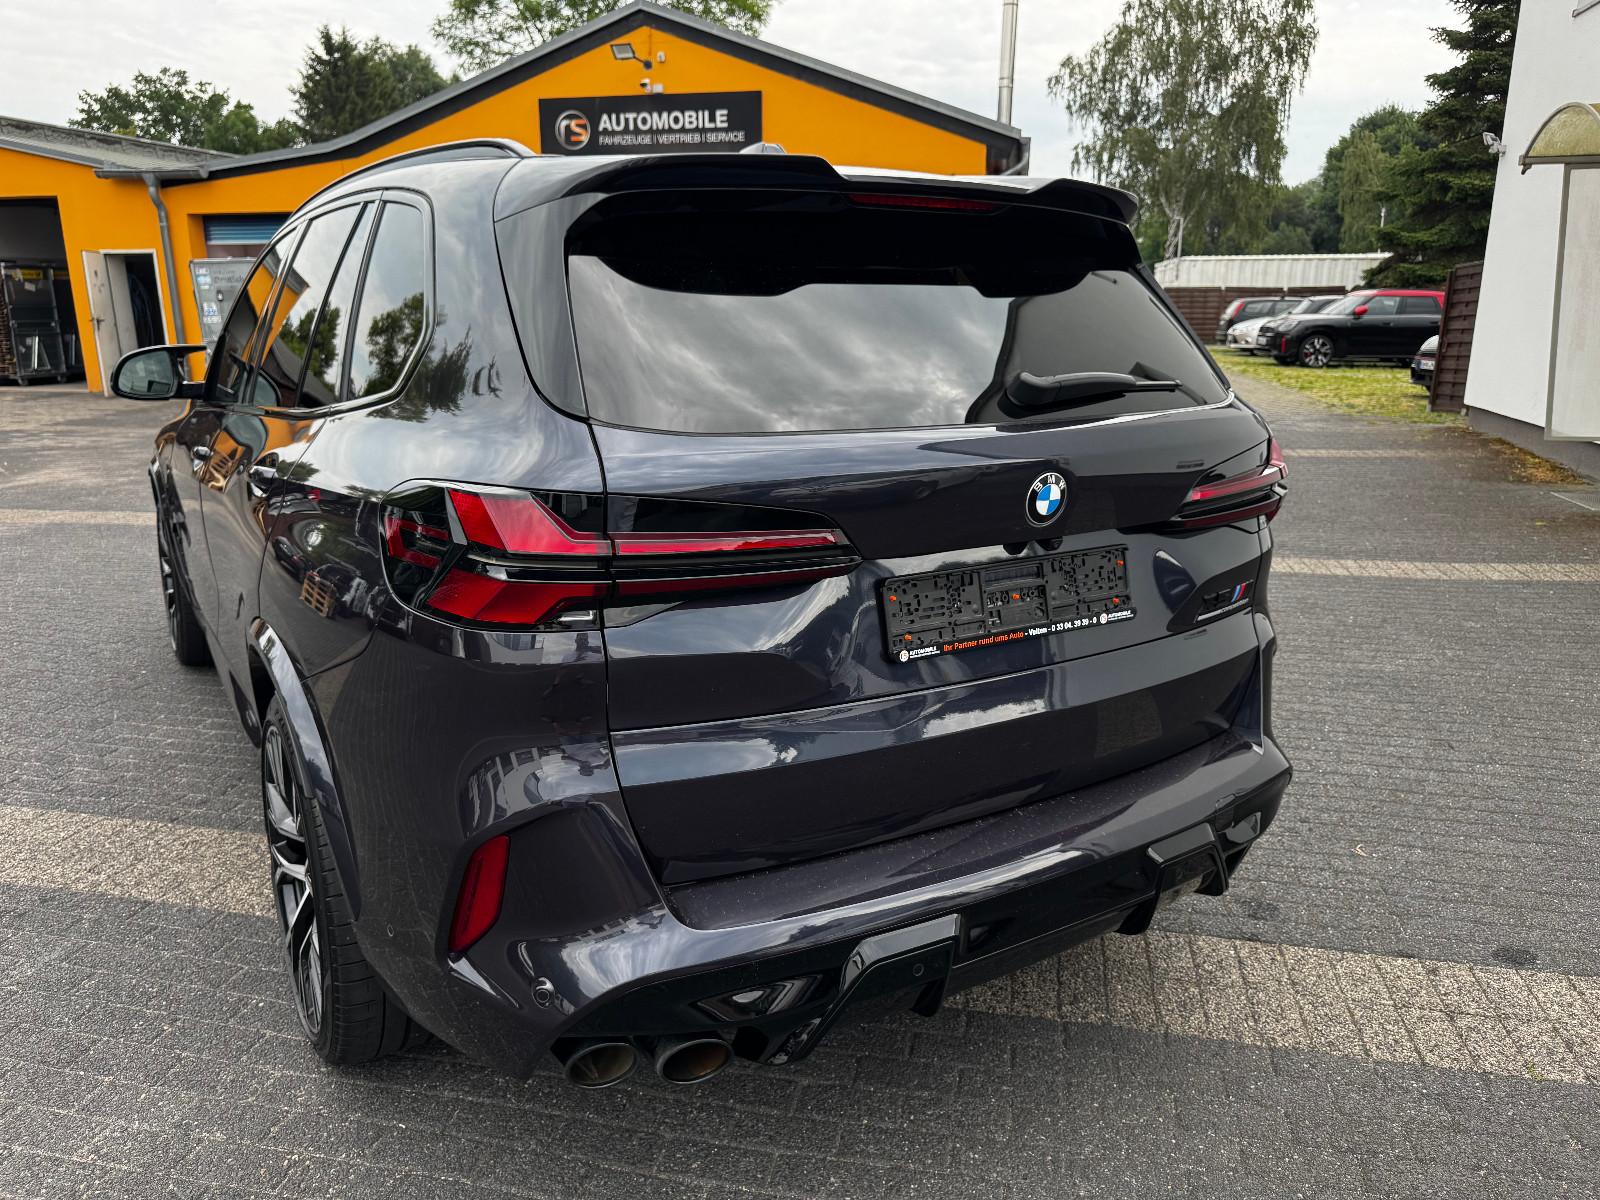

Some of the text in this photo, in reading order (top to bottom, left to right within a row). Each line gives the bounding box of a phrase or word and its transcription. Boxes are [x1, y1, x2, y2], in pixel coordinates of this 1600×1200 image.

[598, 109, 729, 132] AUTOMOBILE
[599, 133, 652, 146] FAHRZEUGE
[657, 132, 701, 145] VERTRIEB
[706, 130, 745, 143] SERVICE
[943, 644, 953, 652] Ihr
[954, 641, 977, 650] Partner
[978, 637, 994, 646] rund
[995, 635, 1009, 643] ums
[1009, 631, 1024, 640] Auto
[1056, 622, 1064, 631] 33
[1074, 620, 1081, 628] 39
[1082, 618, 1089, 626] 39
